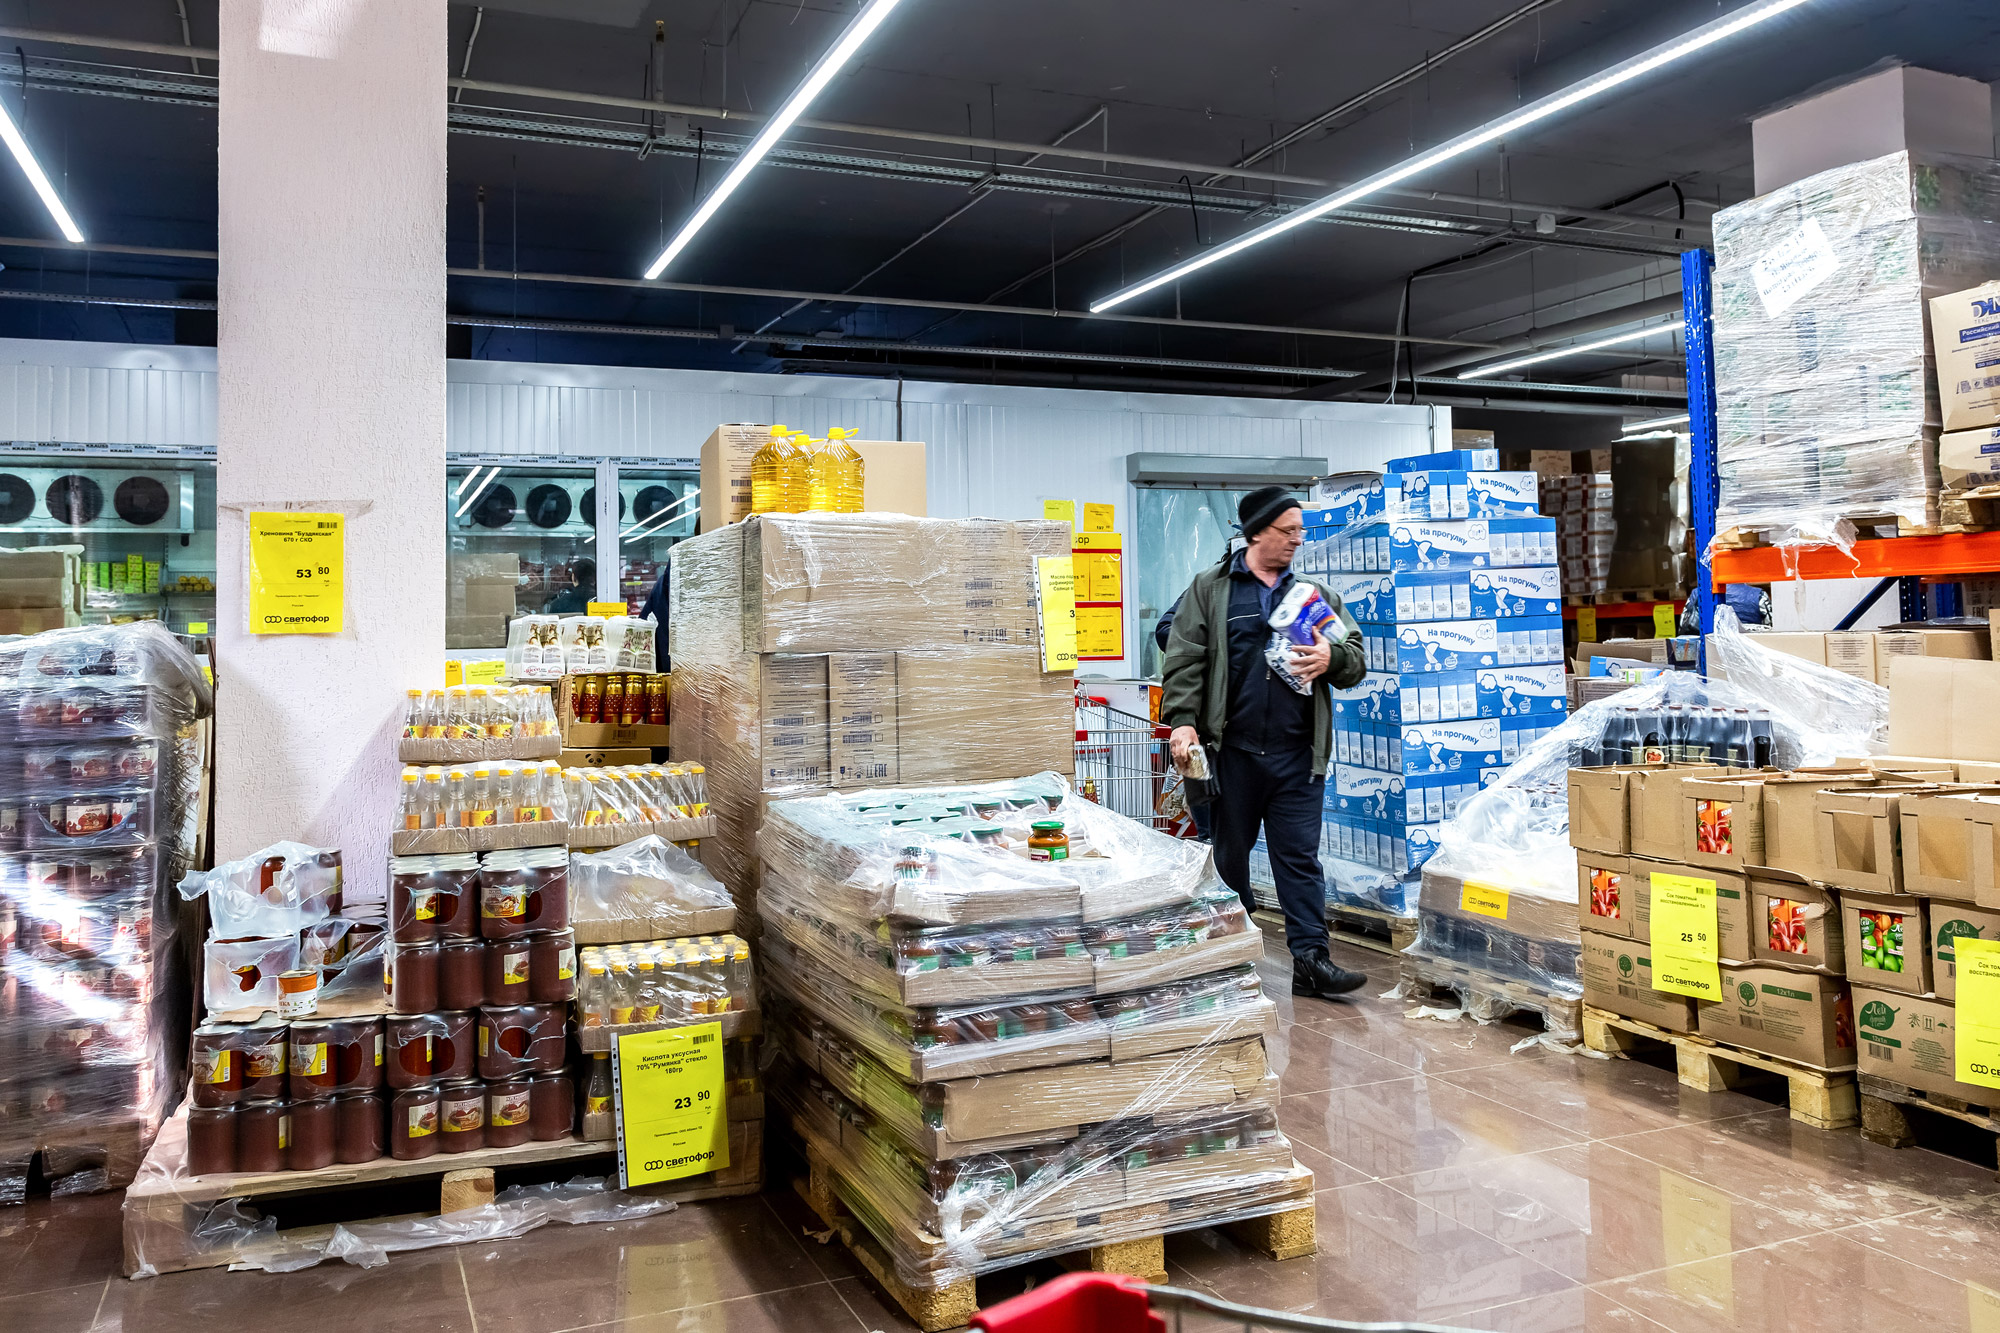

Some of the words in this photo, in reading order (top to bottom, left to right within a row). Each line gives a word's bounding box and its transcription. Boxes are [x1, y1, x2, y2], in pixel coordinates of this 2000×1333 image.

[1480, 477, 1489, 486] На
[1490, 478, 1520, 496] прогулку
[1420, 528, 1430, 536] На
[1432, 529, 1468, 546] прогулку
[296, 569, 312, 578] 53
[1343, 587, 1350, 597] На
[1350, 580, 1374, 593] прогулку
[1498, 575, 1508, 583] На
[1510, 577, 1541, 593] прогулку
[1428, 628, 1438, 636] На
[1440, 629, 1476, 645] прогулку
[1515, 675, 1546, 690] прогулку
[1432, 729, 1443, 737] На
[1444, 730, 1479, 746] прогулку
[874, 764, 888, 777] EAC
[1350, 781, 1357, 790] На
[1358, 777, 1383, 787] прогулку
[1477, 900, 1500, 910] светофор
[1660, 899, 1699, 908] восстановленный
[1681, 932, 1693, 942] 25
[1697, 933, 1706, 941] 50
[1978, 962, 1989, 970] Сок
[1675, 977, 1710, 990] светофор
[642, 1054, 670, 1063] Кислота
[672, 1048, 701, 1060] уксусная
[686, 1055, 708, 1063] стекло
[665, 1067, 683, 1075] 180гр
[674, 1097, 692, 1109] 23
[697, 1090, 710, 1101] 90
[666, 1150, 715, 1167] светофор
